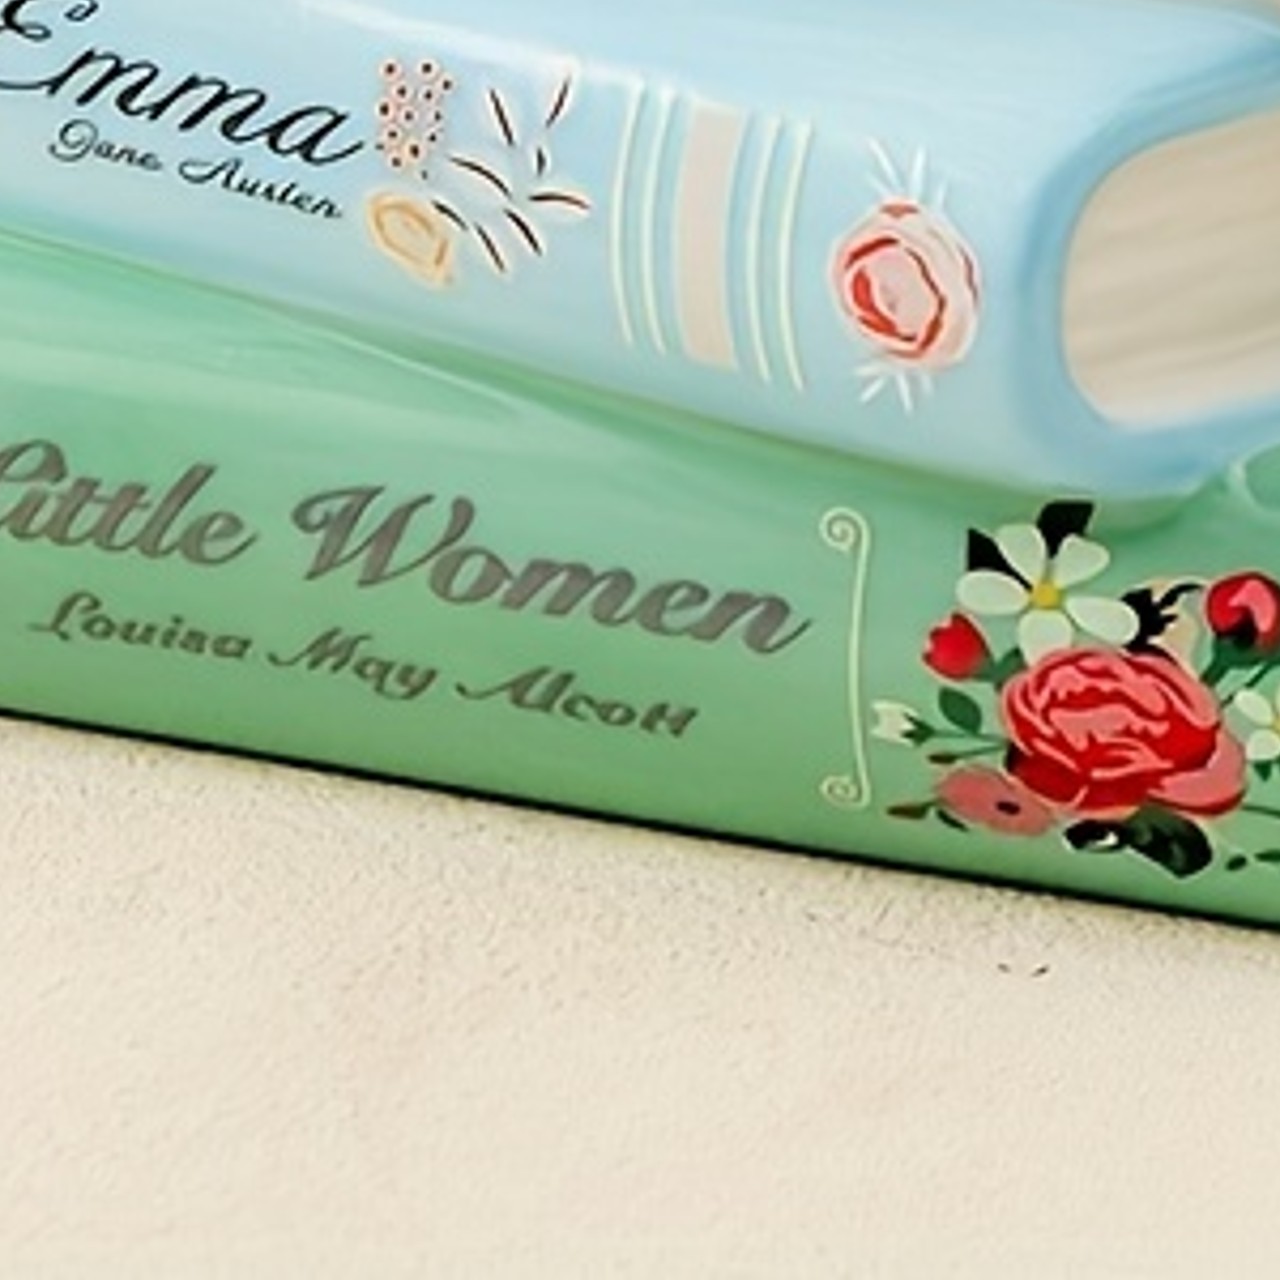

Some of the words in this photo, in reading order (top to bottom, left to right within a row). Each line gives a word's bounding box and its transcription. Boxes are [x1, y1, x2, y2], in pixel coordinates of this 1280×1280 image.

[48, 118, 163, 173] Jane
[177, 158, 343, 220] Austen
[291, 483, 814, 656] Women
[29, 591, 252, 661] Louisa
[267, 625, 437, 702] May
[453, 665, 699, 739] Alcott
